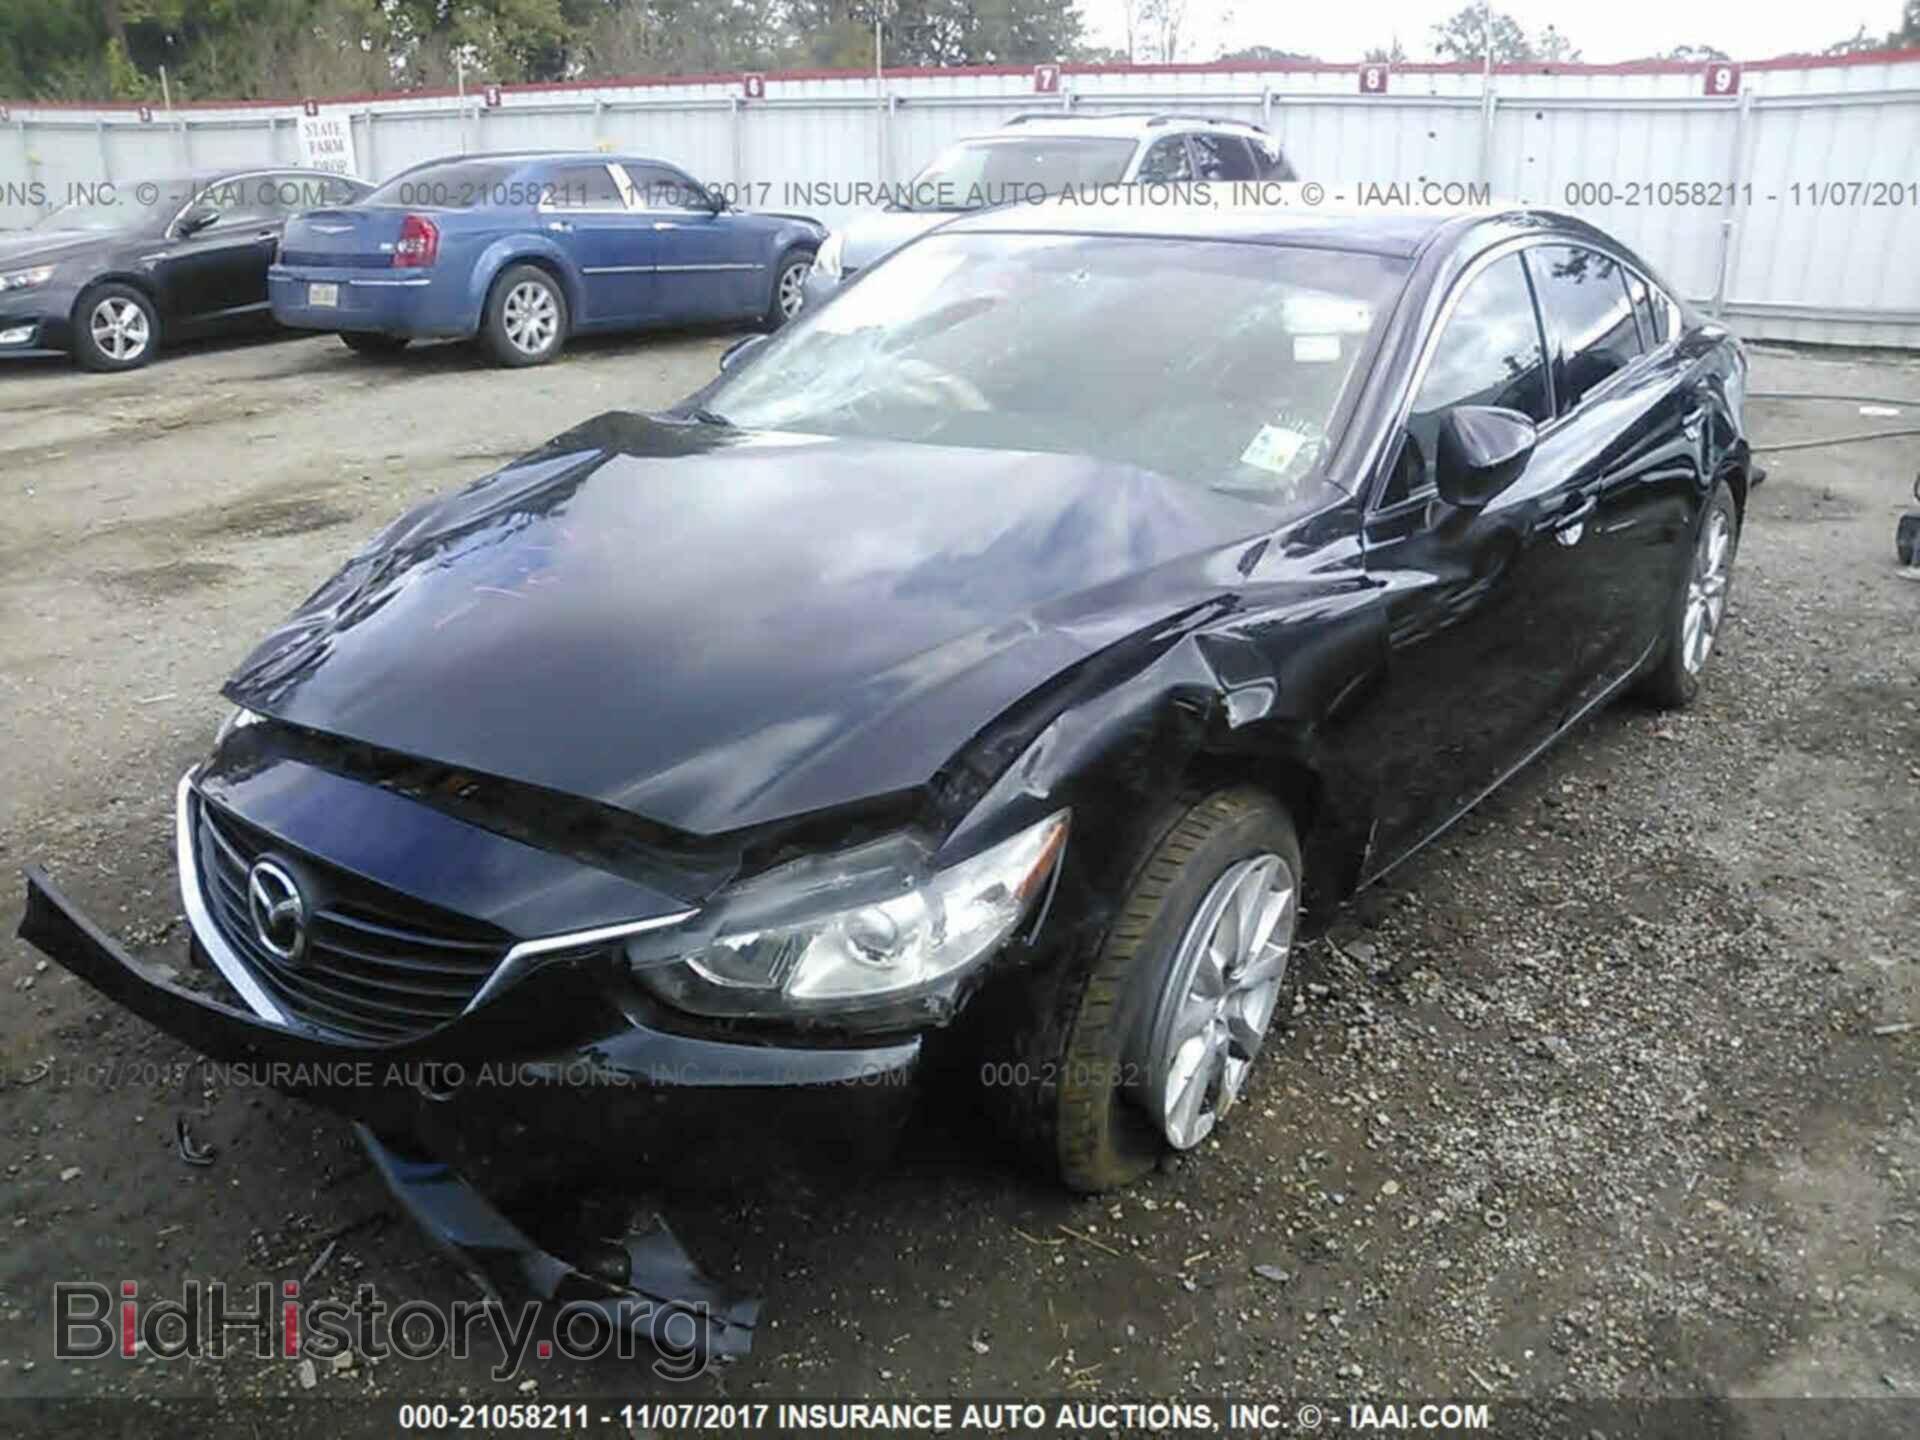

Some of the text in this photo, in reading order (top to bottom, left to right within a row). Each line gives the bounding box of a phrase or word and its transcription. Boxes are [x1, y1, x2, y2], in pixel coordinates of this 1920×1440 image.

[1041, 69, 1052, 89] 7
[1367, 69, 1379, 88] 8
[1715, 68, 1730, 91] 9
